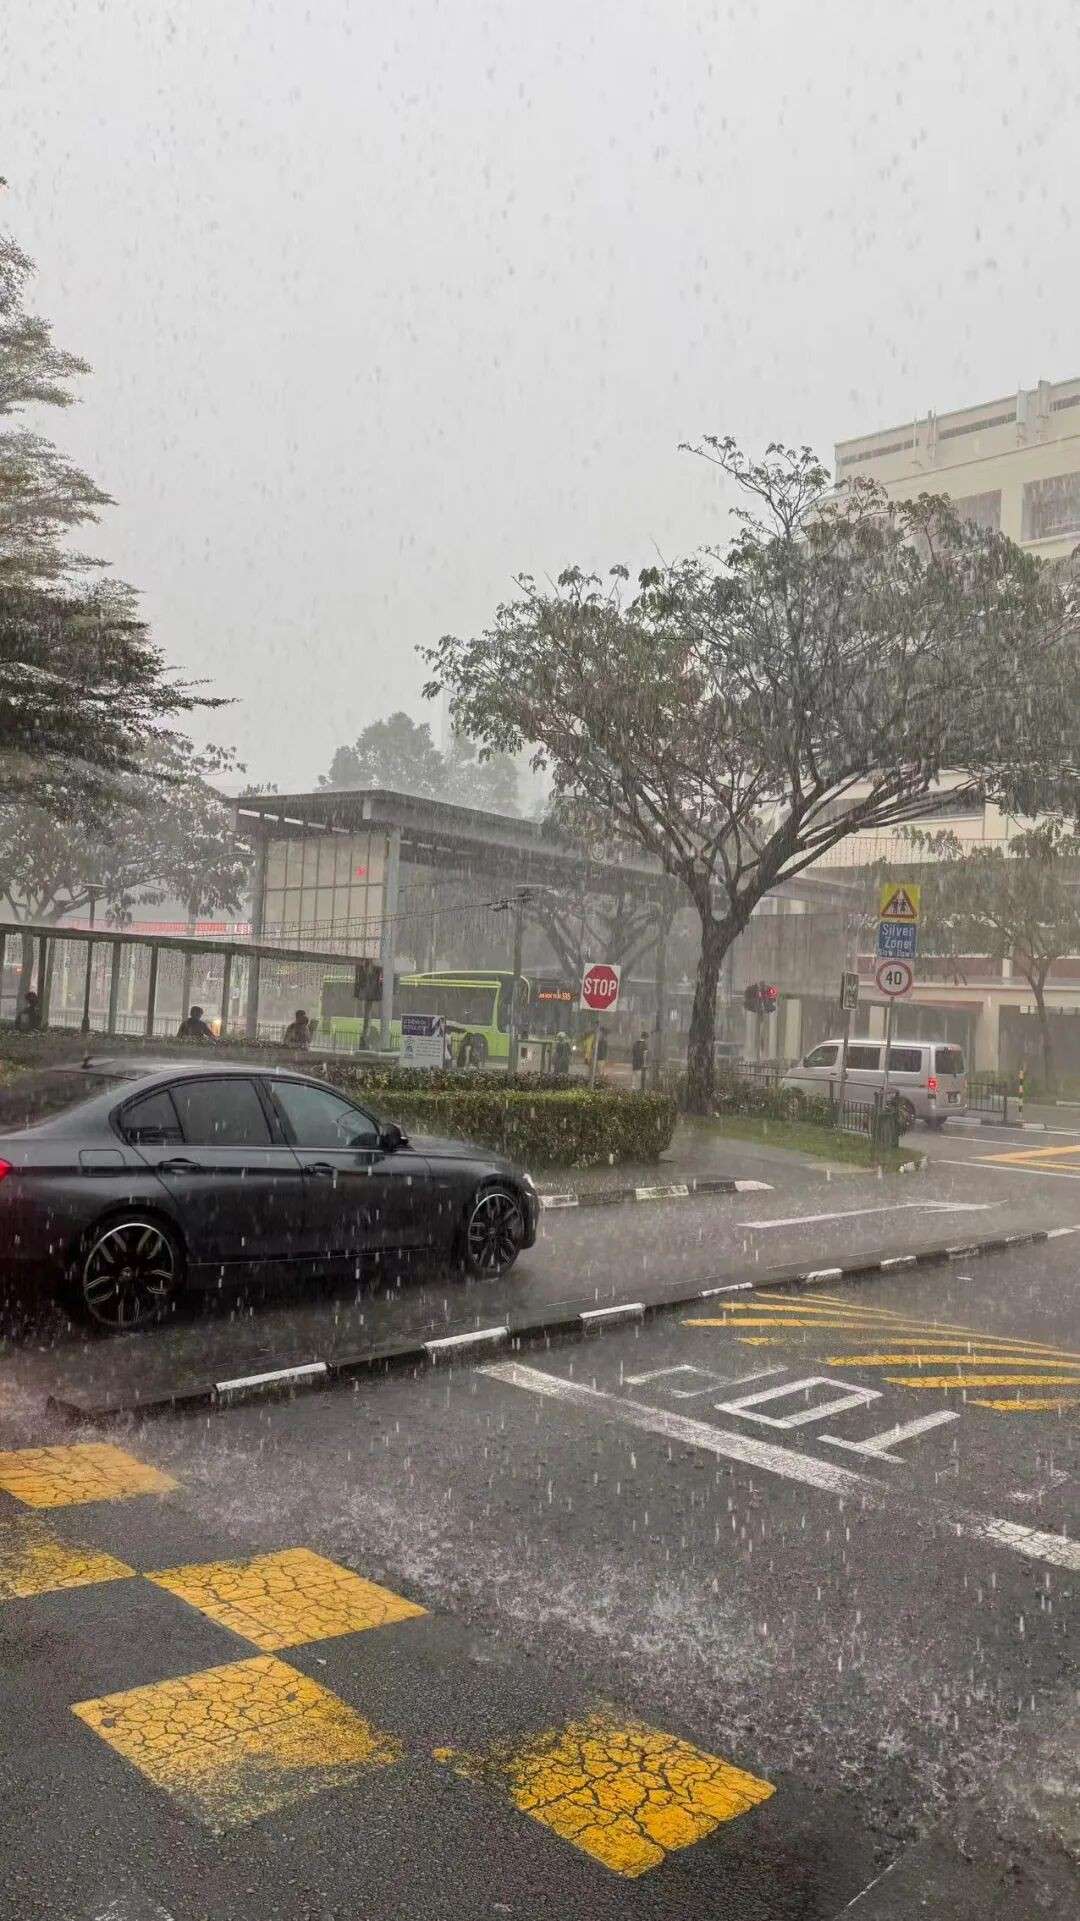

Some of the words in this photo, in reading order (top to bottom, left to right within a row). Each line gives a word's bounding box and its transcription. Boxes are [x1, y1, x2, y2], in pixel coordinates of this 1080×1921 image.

[882, 923, 914, 936] Silver
[886, 971, 902, 985] 40
[584, 977, 617, 997] STOP
